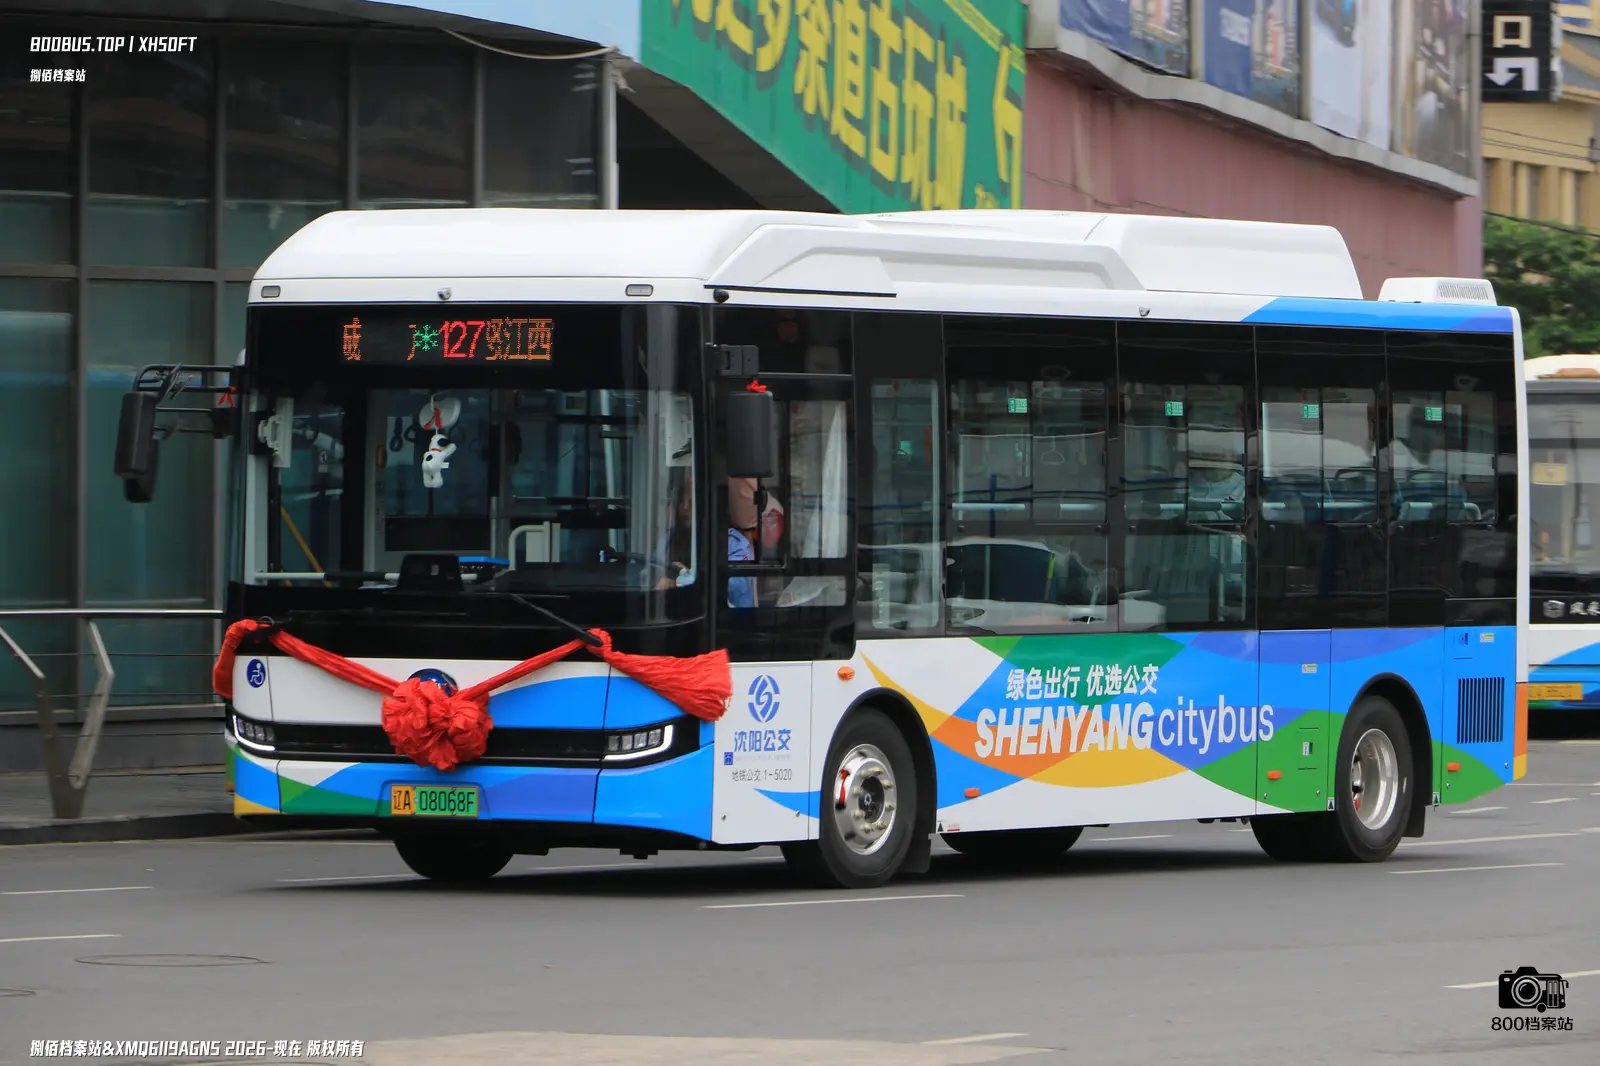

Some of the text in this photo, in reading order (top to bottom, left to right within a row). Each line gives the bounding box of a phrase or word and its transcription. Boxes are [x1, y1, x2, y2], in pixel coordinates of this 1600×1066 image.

[438, 320, 485, 358] 127
[1006, 663, 1159, 701] 绿色出行 优选公交
[734, 728, 791, 752] 沈阳公交
[974, 694, 1275, 758] SHENYANG citybus
[764, 768, 792, 781] 1-5020
[420, 790, 475, 812] 08068F
